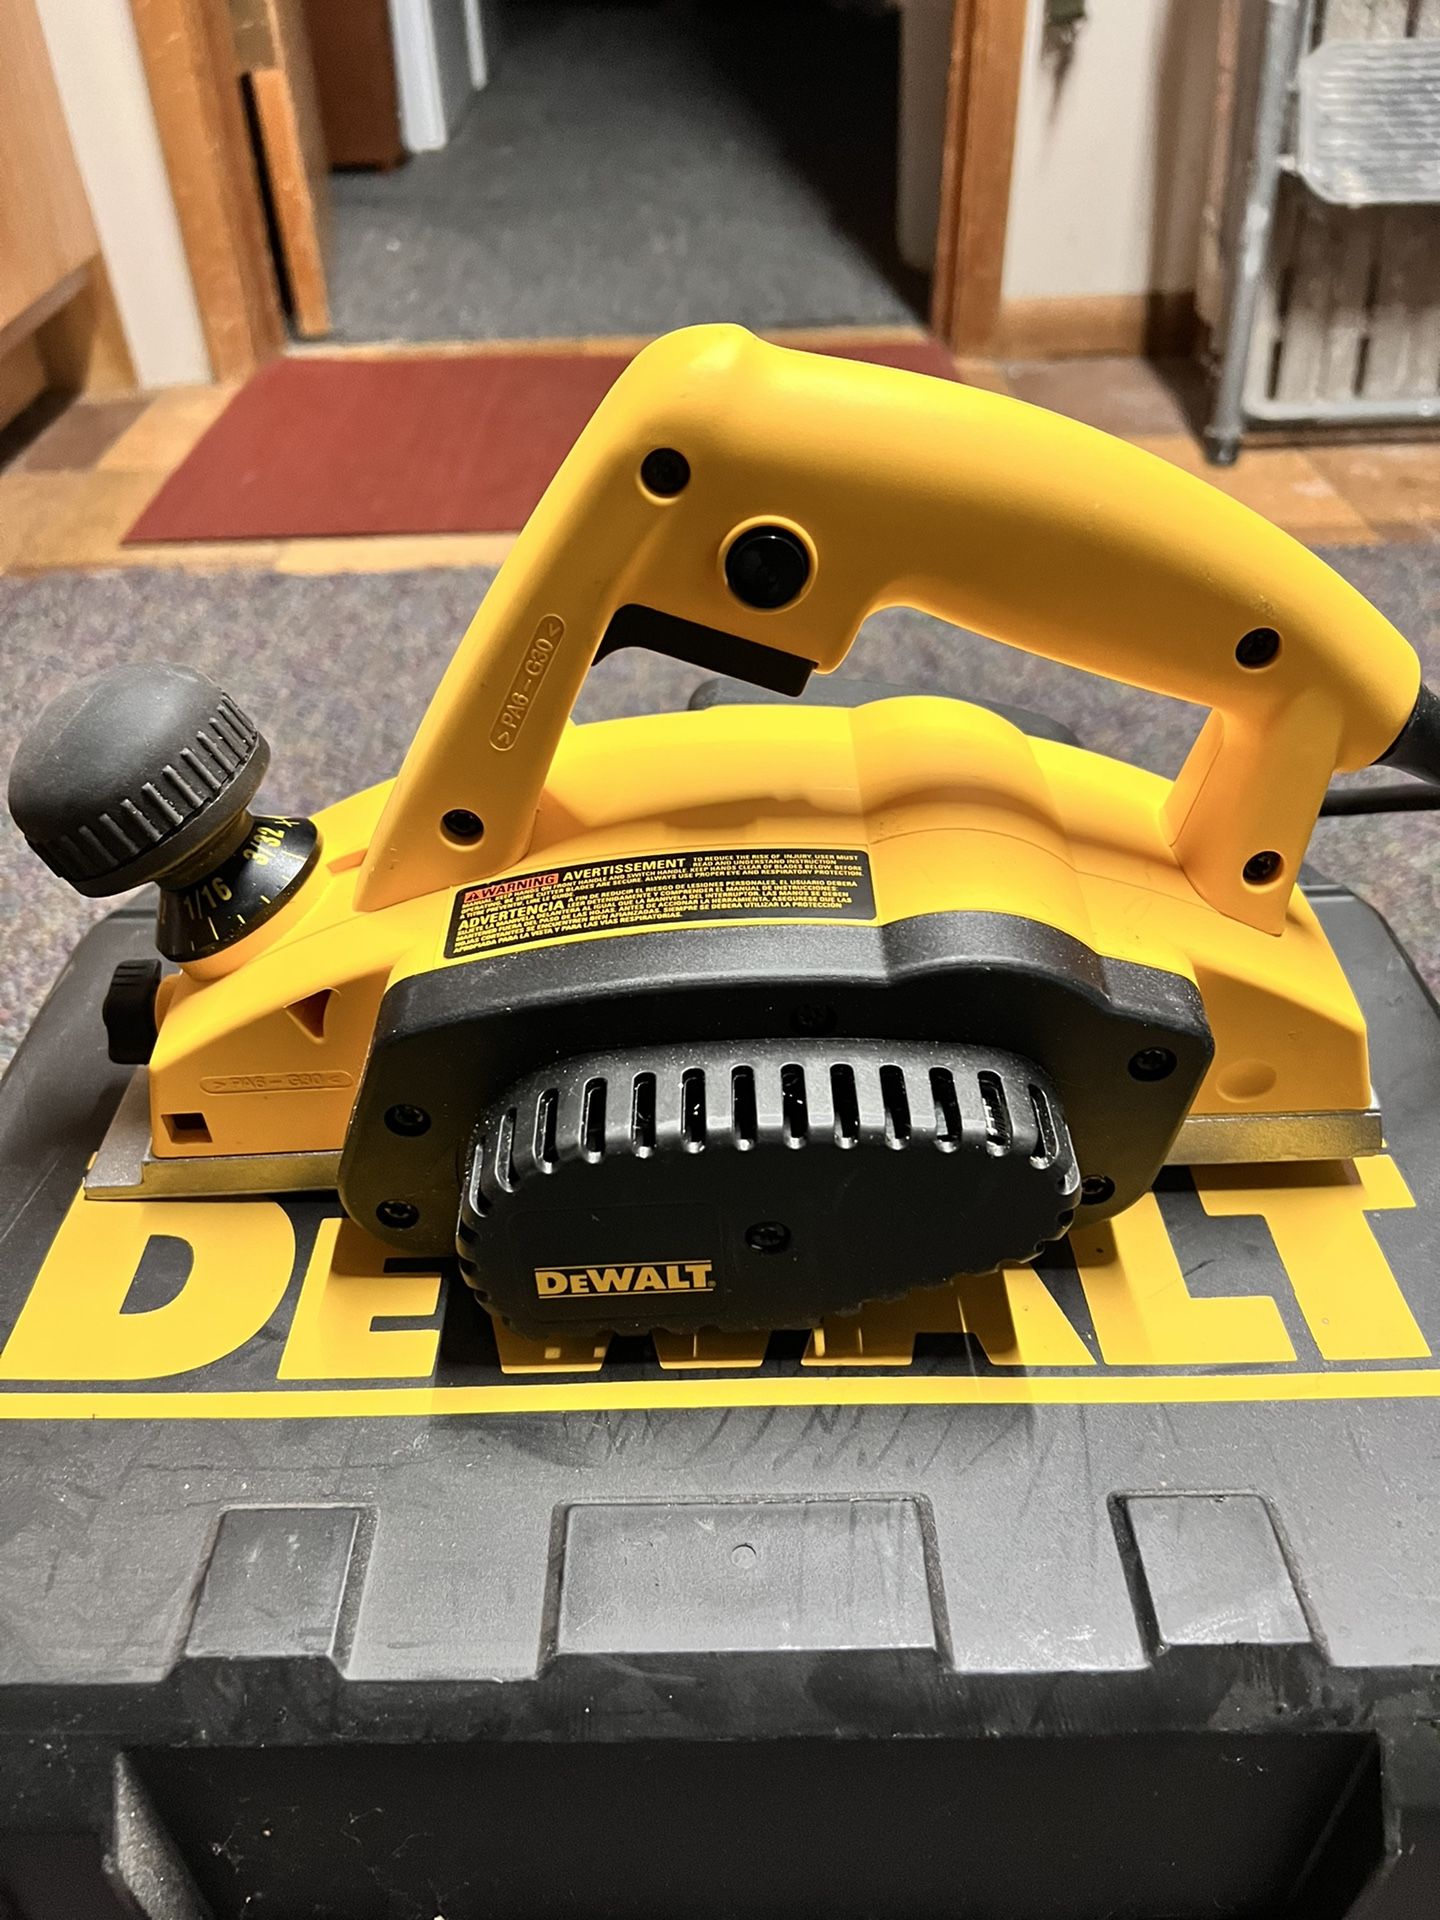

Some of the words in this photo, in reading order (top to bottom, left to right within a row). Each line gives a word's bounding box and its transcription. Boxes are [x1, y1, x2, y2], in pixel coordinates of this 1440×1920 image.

[482, 875, 555, 898] WARNING
[563, 858, 687, 882] AVERTISSEMENT
[514, 887, 540, 897] HANDS
[553, 881, 577, 889] FRONT
[578, 876, 607, 885] HANDLE
[515, 894, 534, 902] SURE
[536, 888, 565, 897] CUTTER
[566, 884, 595, 892] BLADES
[645, 874, 677, 882] ALWAYS
[601, 888, 634, 898] REDUCIR
[645, 884, 674, 892] RIESGO
[687, 881, 724, 889] LESIONES
[184, 877, 233, 920] 1/16
[587, 893, 652, 905] DETENIDAMENTE
[660, 887, 714, 896] COMPRENDER
[455, 937, 479, 947] HOJAS
[480, 927, 524, 942] CORTANTES
[537, 917, 588, 929] ENCUENTREN
[663, 905, 698, 913] SIEMPRE
[456, 928, 497, 942] MANTENER
[499, 923, 522, 932] FUERA
[523, 919, 537, 927] DEL
[539, 915, 560, 924] PASO
[658, 899, 698, 908] ACCIONAR
[457, 925, 483, 936] SUJETE
[496, 913, 535, 927] MANIVELA
[536, 907, 580, 919] DELANTERA
[594, 901, 616, 910] IGUAL
[647, 894, 687, 903] MANIVELA
[458, 900, 565, 930] ADVERTENCIA
[453, 940, 497, 953] APROPIADA
[498, 934, 519, 943] PARA
[531, 928, 553, 937] VISTA
[561, 923, 582, 932] PARA
[583, 920, 598, 928] LAS
